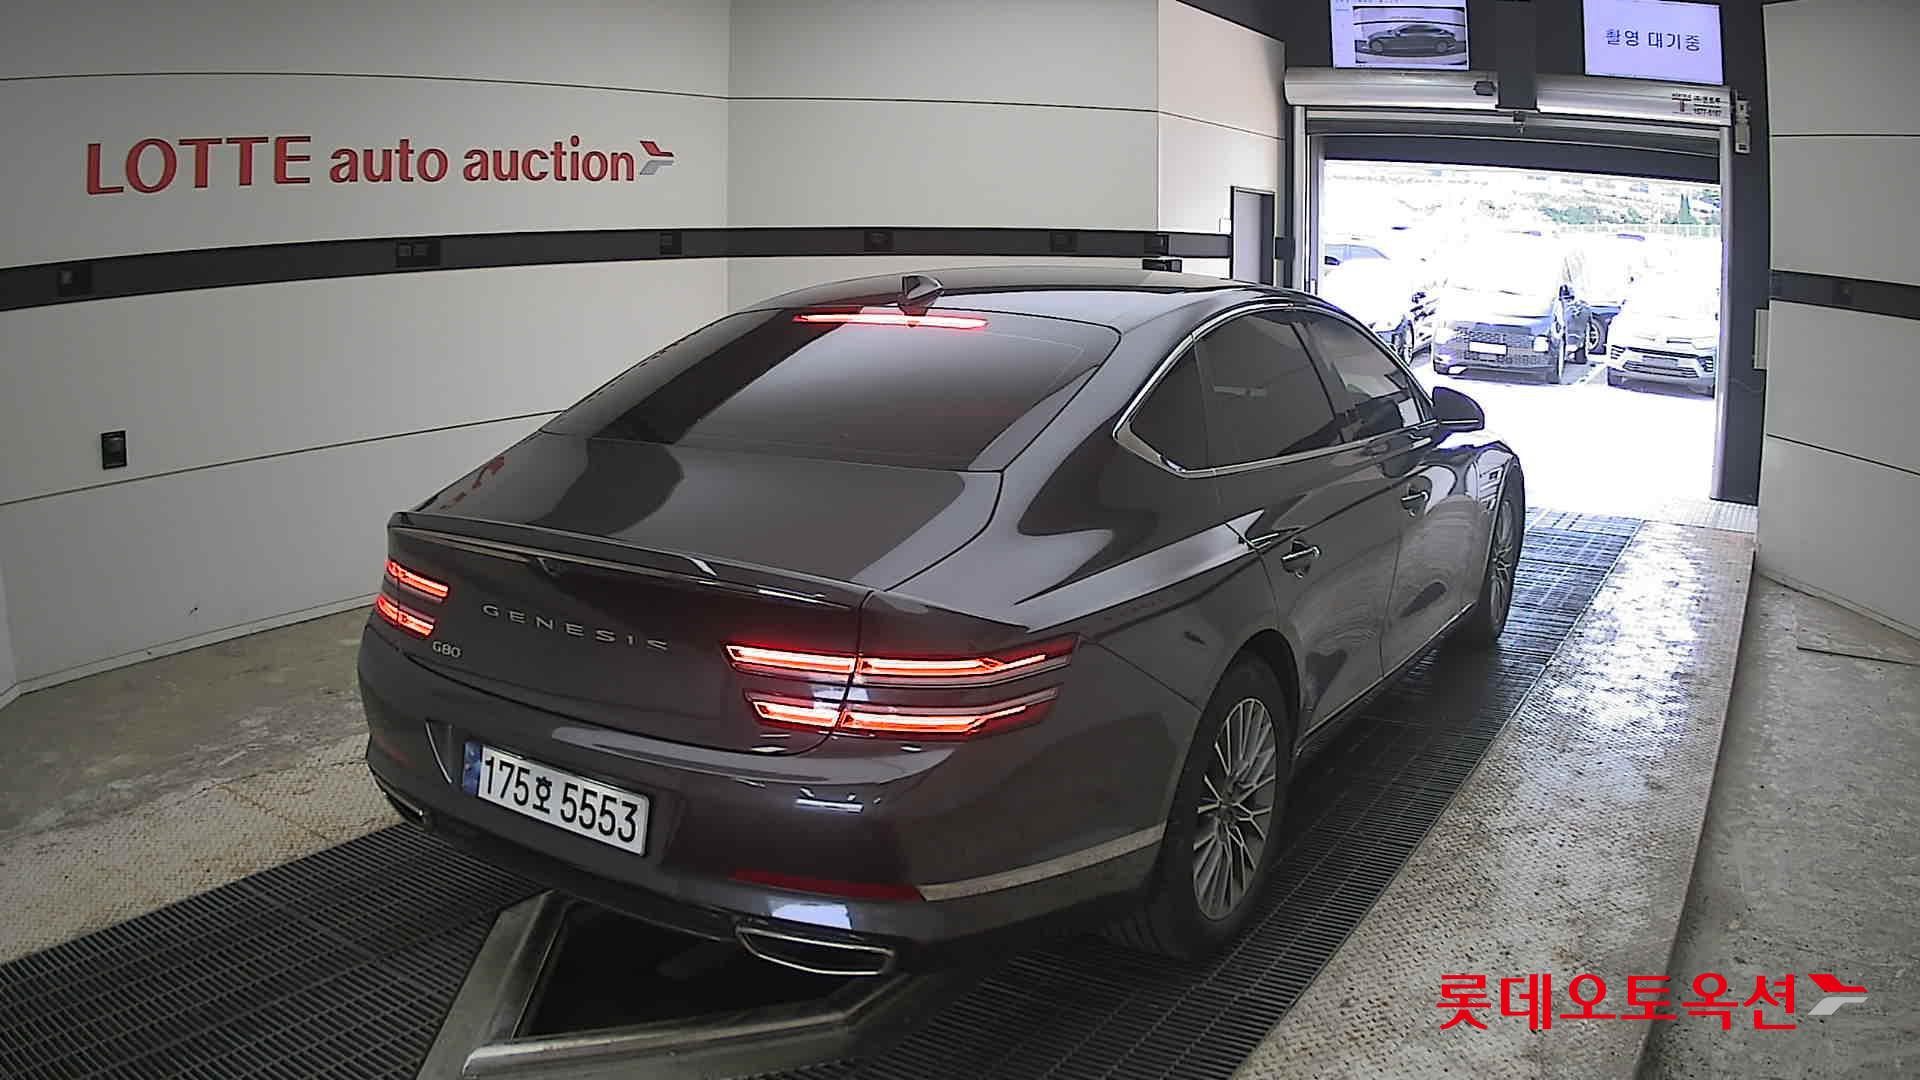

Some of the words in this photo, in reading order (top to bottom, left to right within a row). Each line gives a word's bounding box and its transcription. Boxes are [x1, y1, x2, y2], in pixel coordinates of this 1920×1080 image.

[86, 136, 311, 194] LOTTE
[329, 139, 448, 182] auto
[463, 135, 634, 182] auction
[432, 641, 461, 658] G80
[482, 604, 669, 650] GENESIS
[560, 782, 638, 843] 5553
